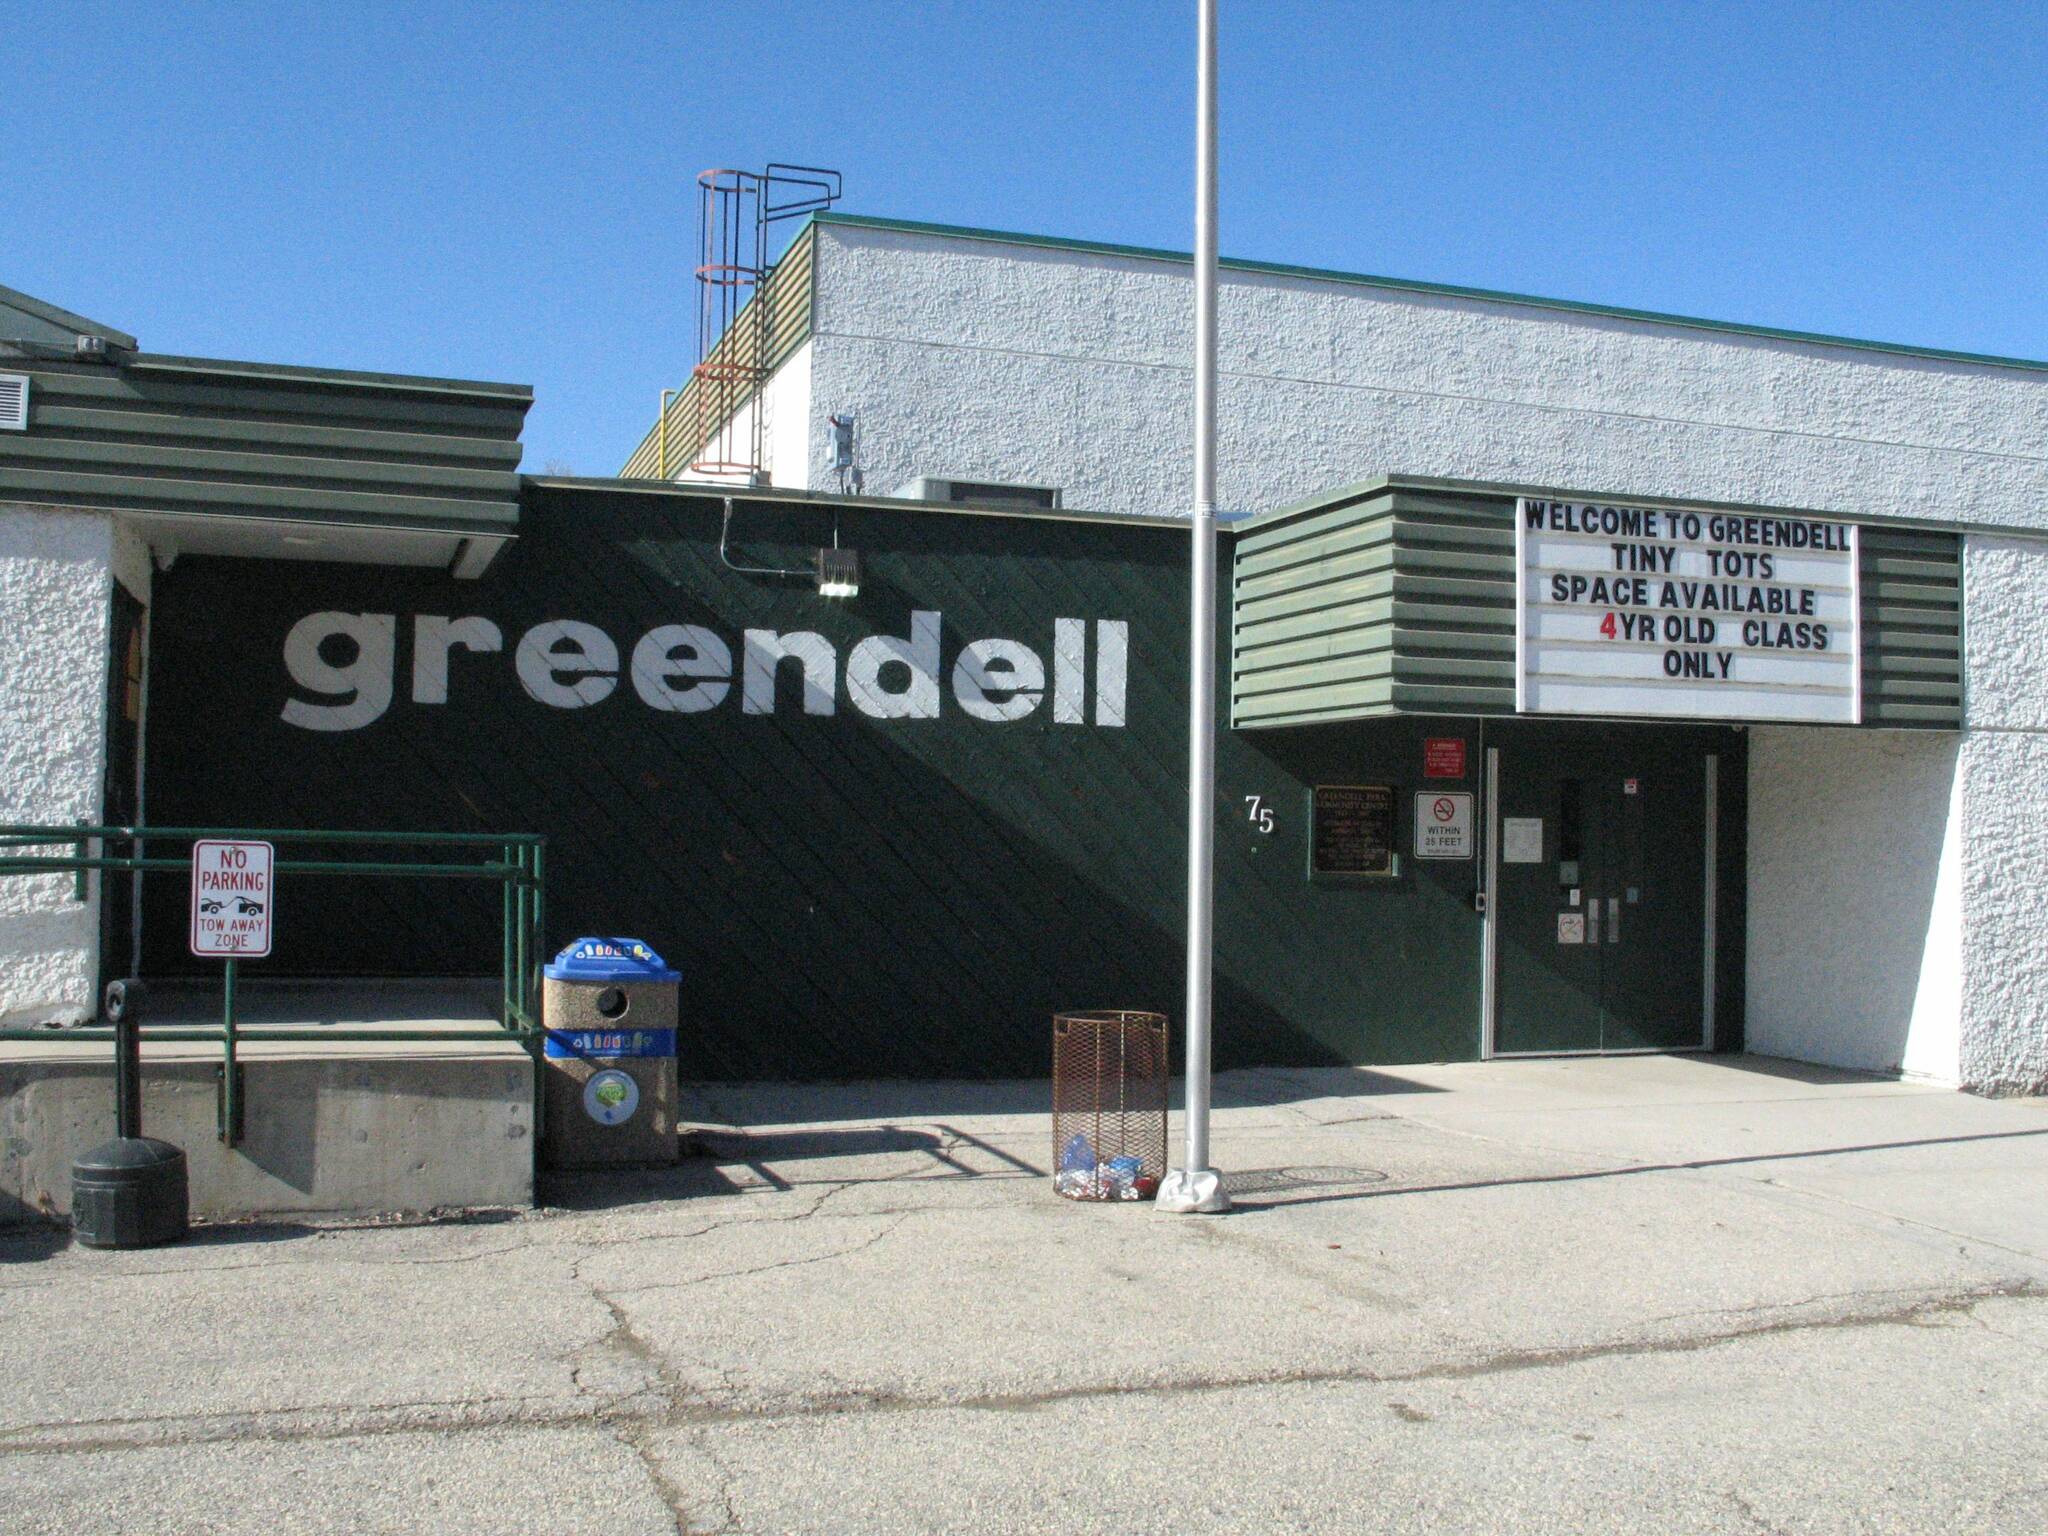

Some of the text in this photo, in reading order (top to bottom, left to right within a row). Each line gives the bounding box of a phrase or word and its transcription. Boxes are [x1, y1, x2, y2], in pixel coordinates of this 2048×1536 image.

[1525, 501, 1850, 551] WELCOME TO GREENDELL
[1611, 543, 1773, 579] TINY TOTS
[1552, 574, 1815, 616] SPACE AVAILABLE
[1664, 619, 1715, 644] OLD
[1743, 620, 1828, 650] CLASS
[281, 609, 1128, 732] greendell
[1664, 650, 1732, 678] ONLY
[1245, 795, 1274, 833] 75
[1427, 825, 1461, 835] WITHIN
[1439, 837, 1462, 846] FEET
[220, 850, 247, 868] NO
[202, 871, 264, 891] PARKING
[200, 919, 264, 932] TOW AWAY
[215, 934, 248, 947] ZONE
